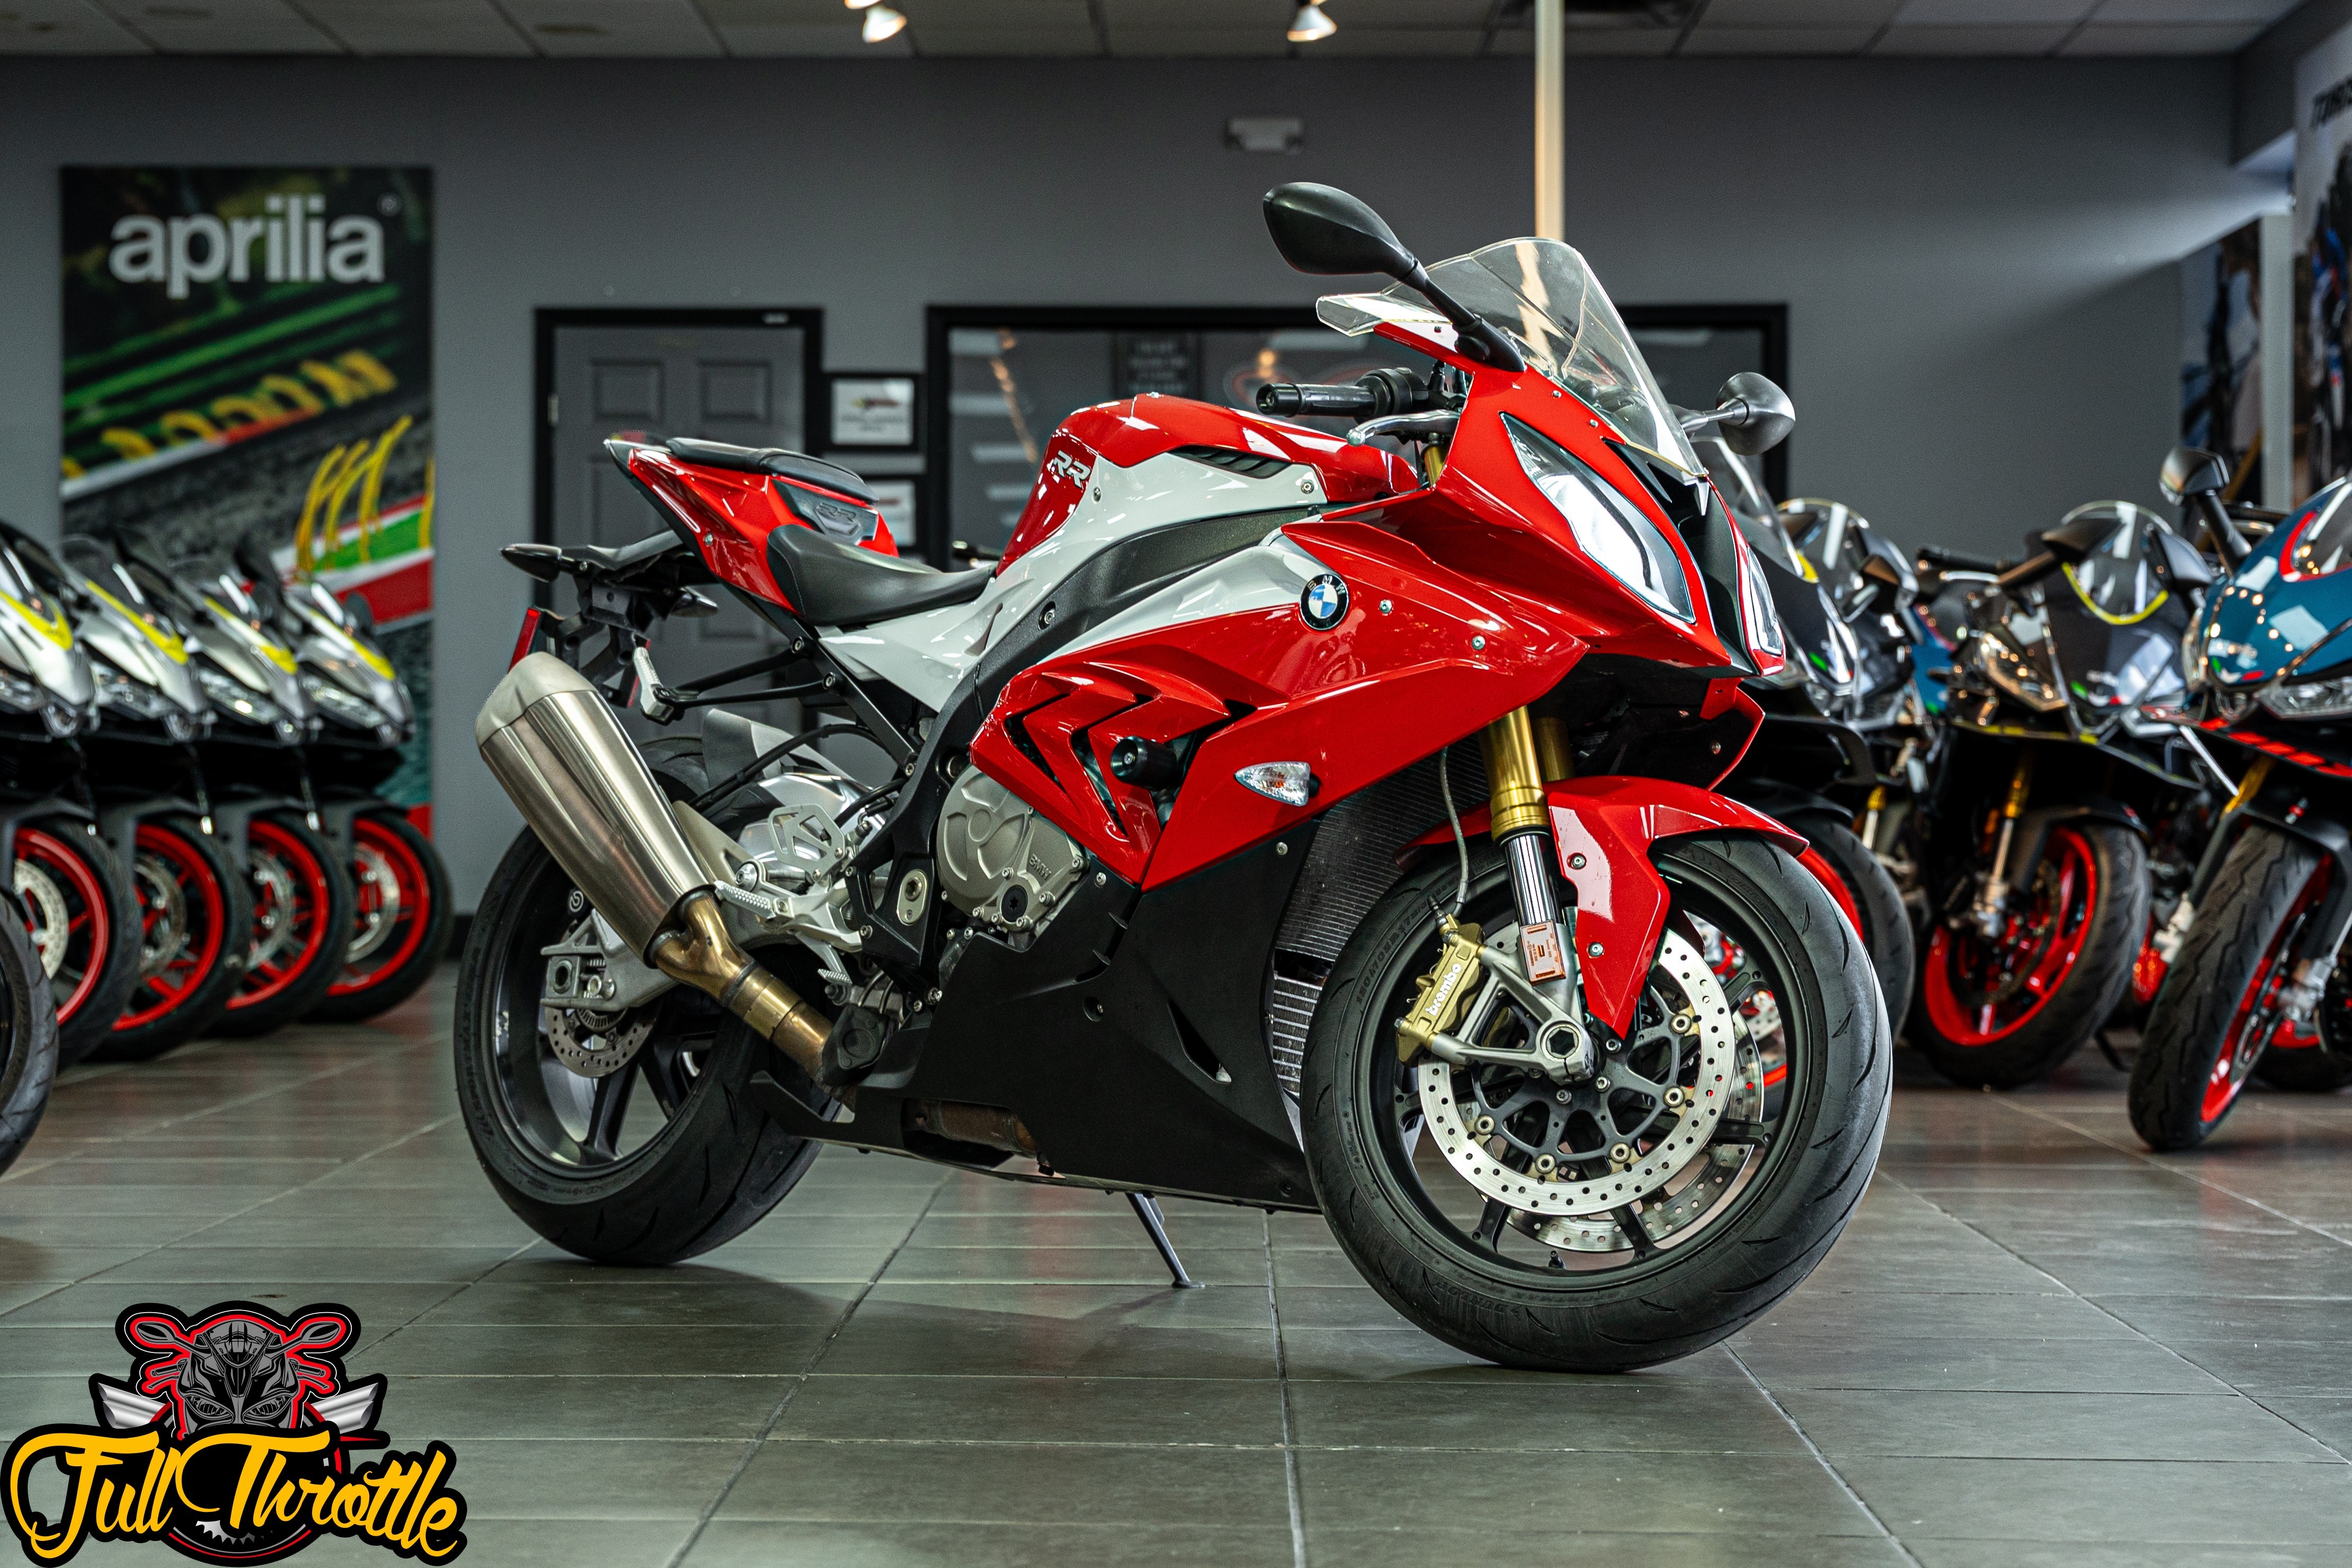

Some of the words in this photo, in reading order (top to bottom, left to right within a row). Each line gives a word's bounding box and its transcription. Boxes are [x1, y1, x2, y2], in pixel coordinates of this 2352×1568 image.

[109, 194, 384, 299] aprilia
[1053, 449, 1091, 488] RR
[816, 502, 857, 523] RR
[1307, 575, 1347, 595] BMW
[1029, 853, 1052, 879] BMW
[1425, 964, 1462, 1017] brembo
[1432, 1281, 1509, 1314] DUNLOP
